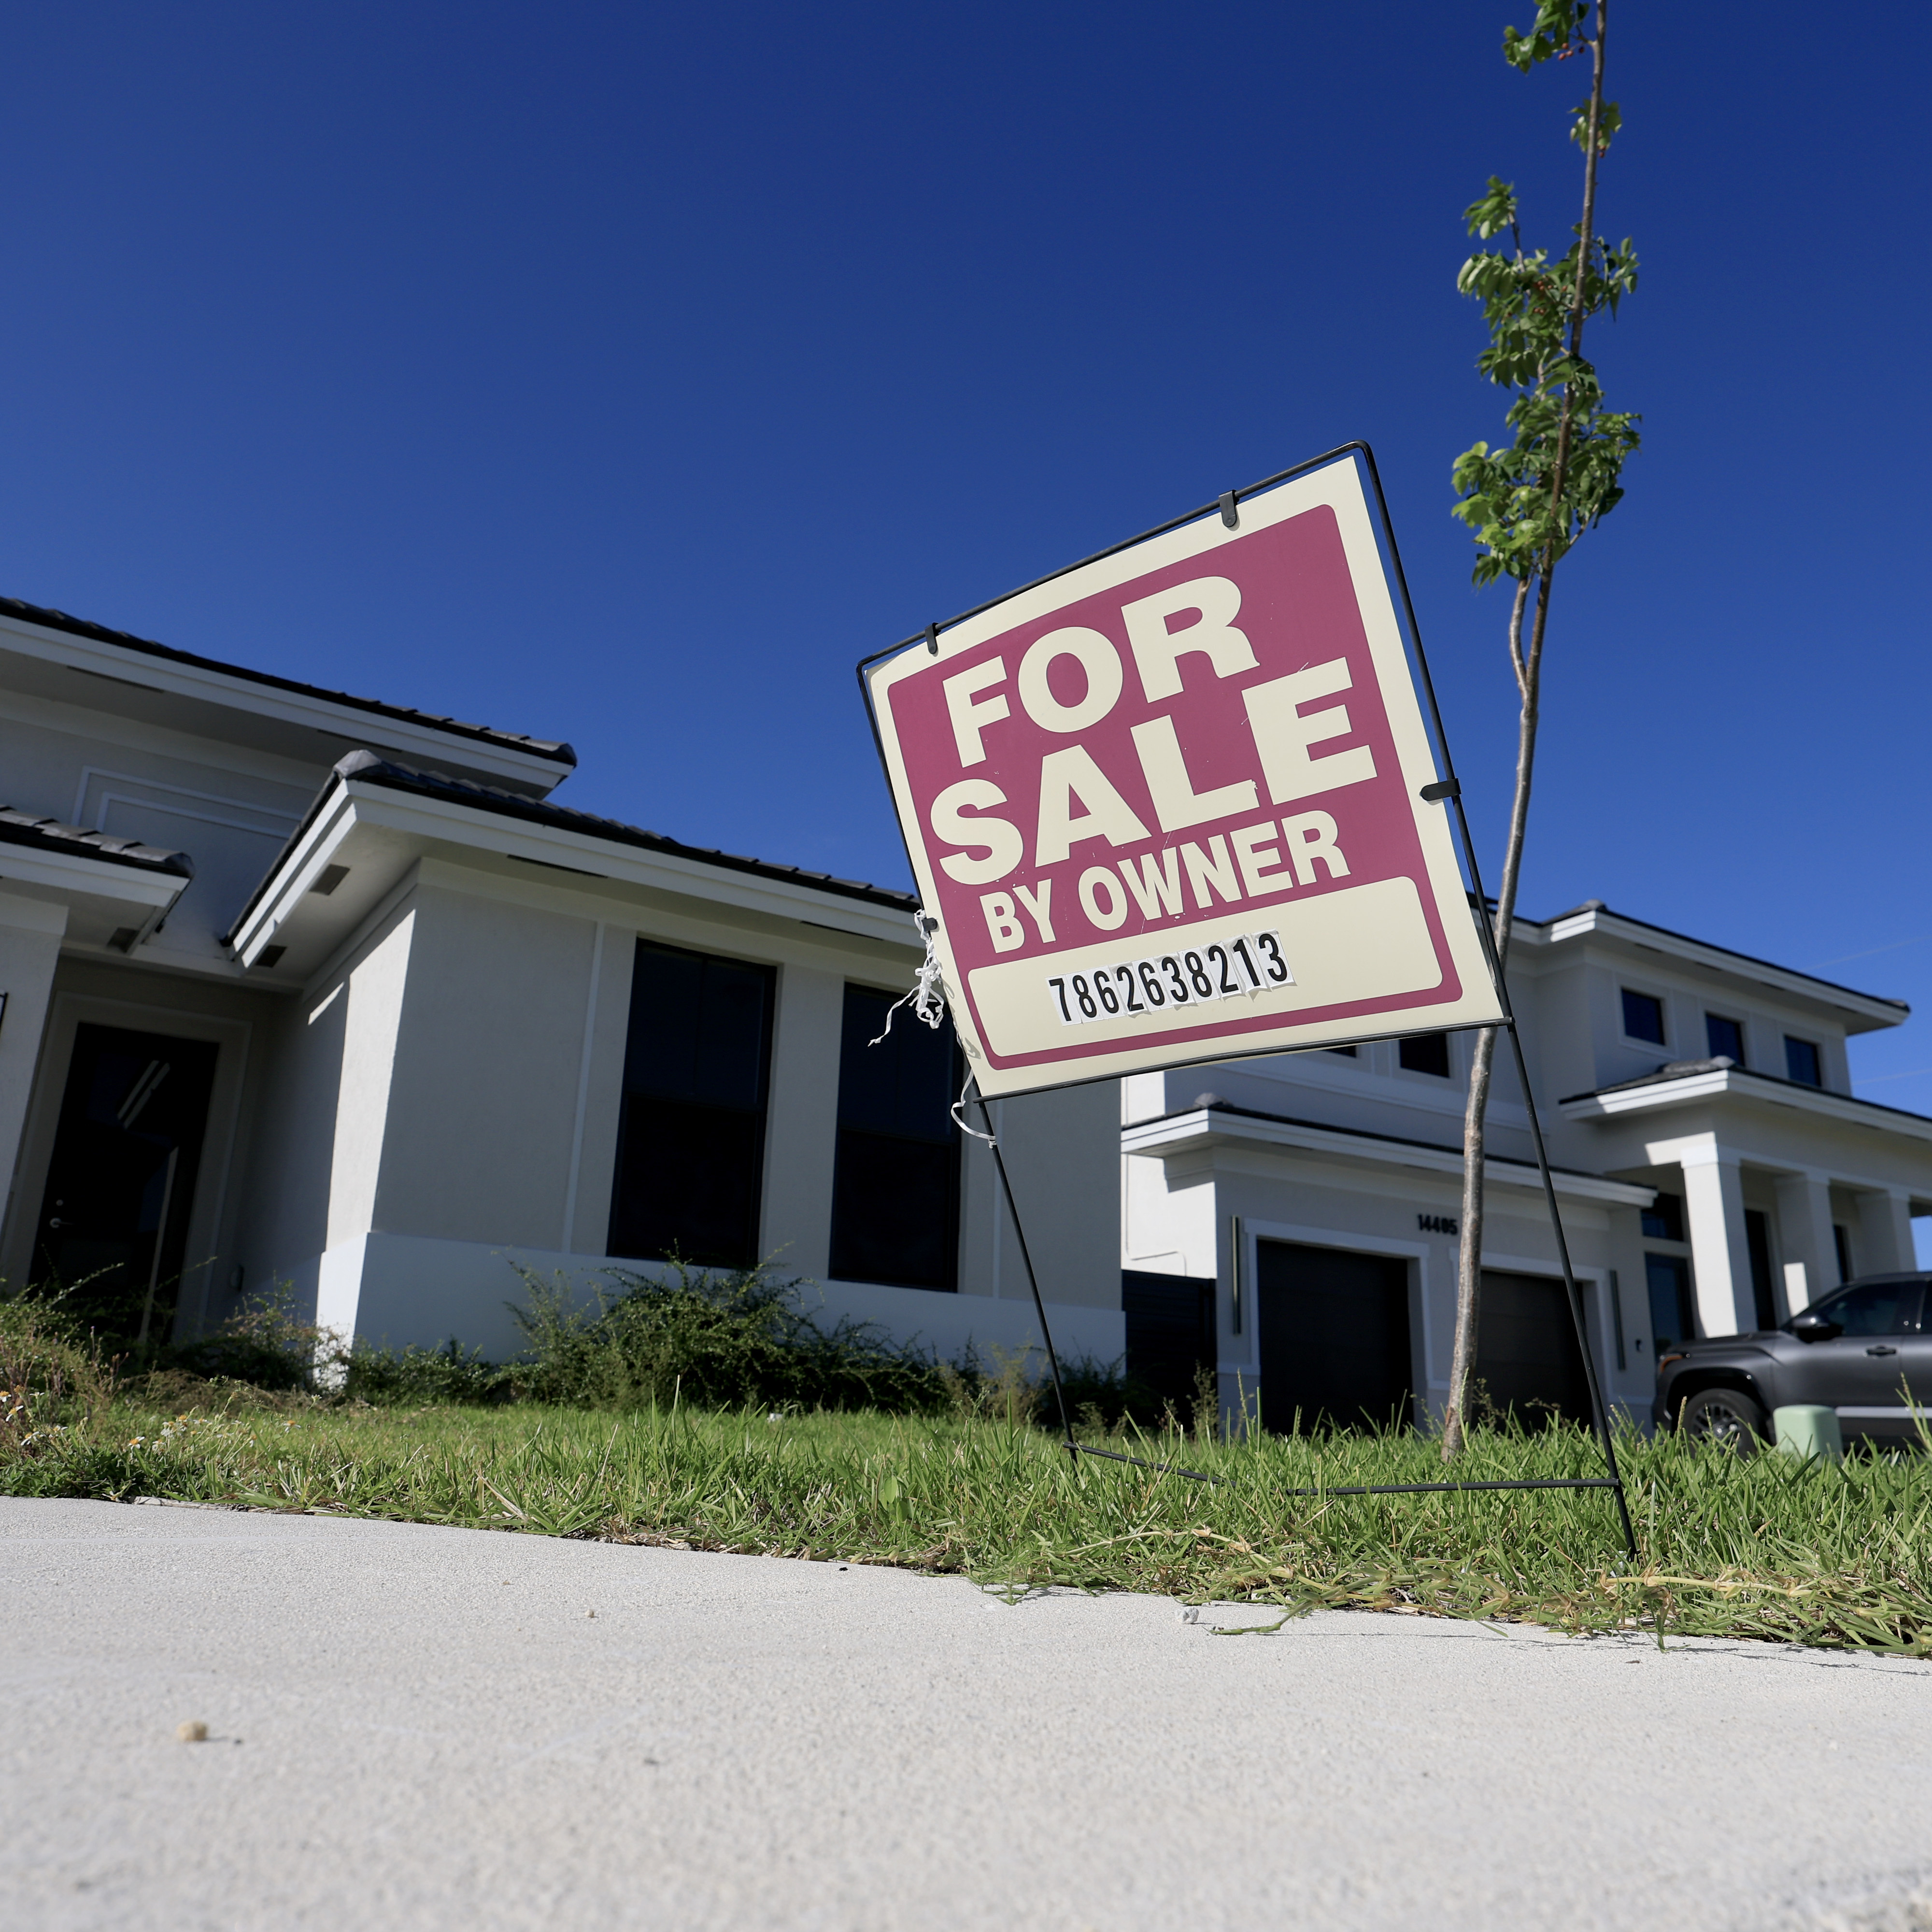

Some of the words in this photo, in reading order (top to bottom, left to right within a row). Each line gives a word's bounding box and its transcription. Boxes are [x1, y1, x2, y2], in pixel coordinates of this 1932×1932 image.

[943, 576, 1260, 767] FOR
[930, 657, 1378, 885] SALE
[980, 879, 1056, 953] BY
[1078, 810, 1351, 931] OWNER
[1050, 934, 1288, 1022] 7862638213
